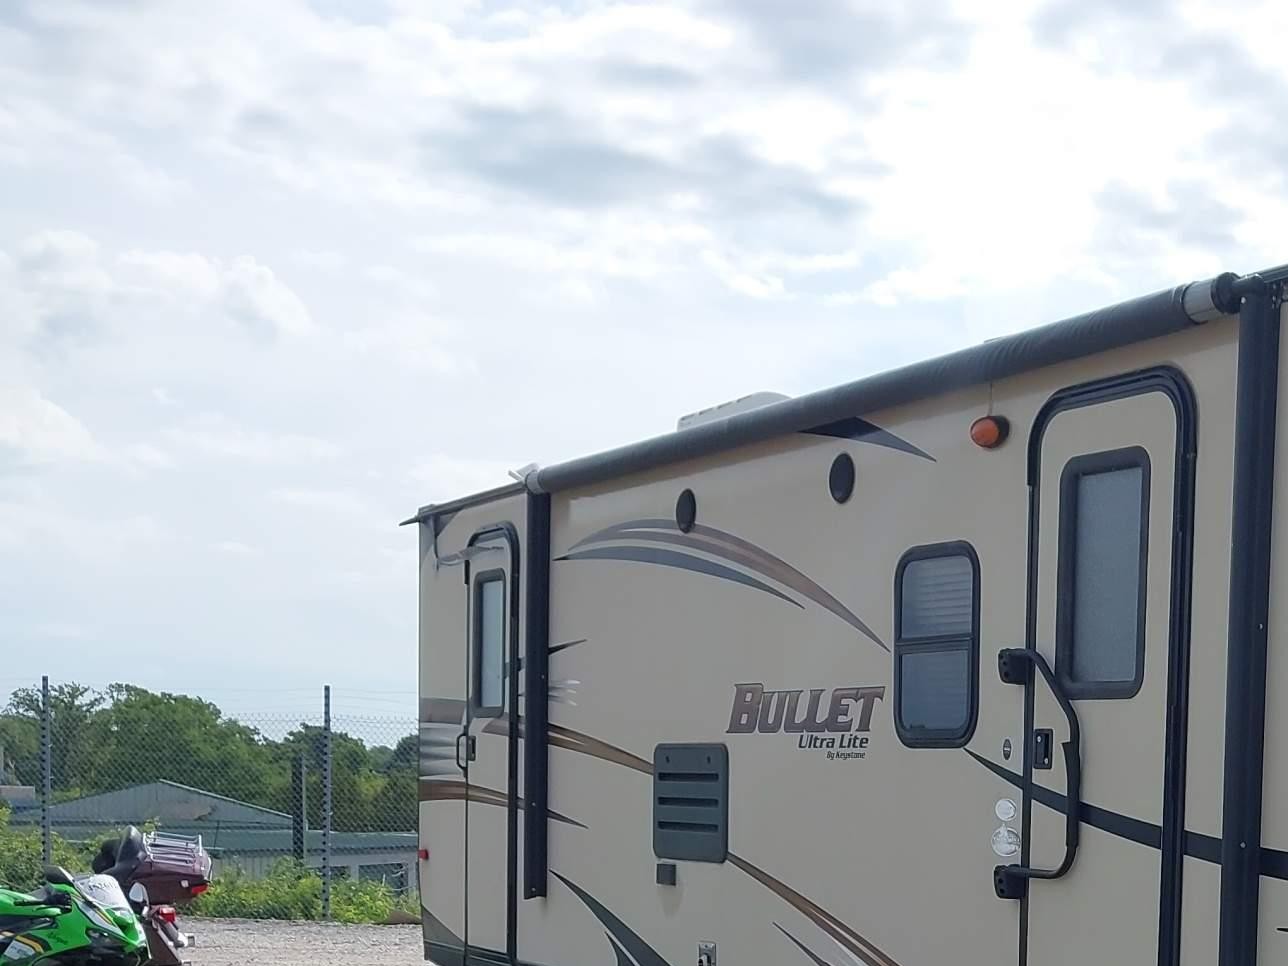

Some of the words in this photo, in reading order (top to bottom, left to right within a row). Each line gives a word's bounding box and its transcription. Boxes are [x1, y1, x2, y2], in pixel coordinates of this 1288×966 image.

[726, 683, 885, 733] BULLET
[798, 734, 835, 749] Ultra
[839, 734, 869, 749] Lite
[827, 751, 835, 760] By
[836, 751, 866, 760] Keystone
